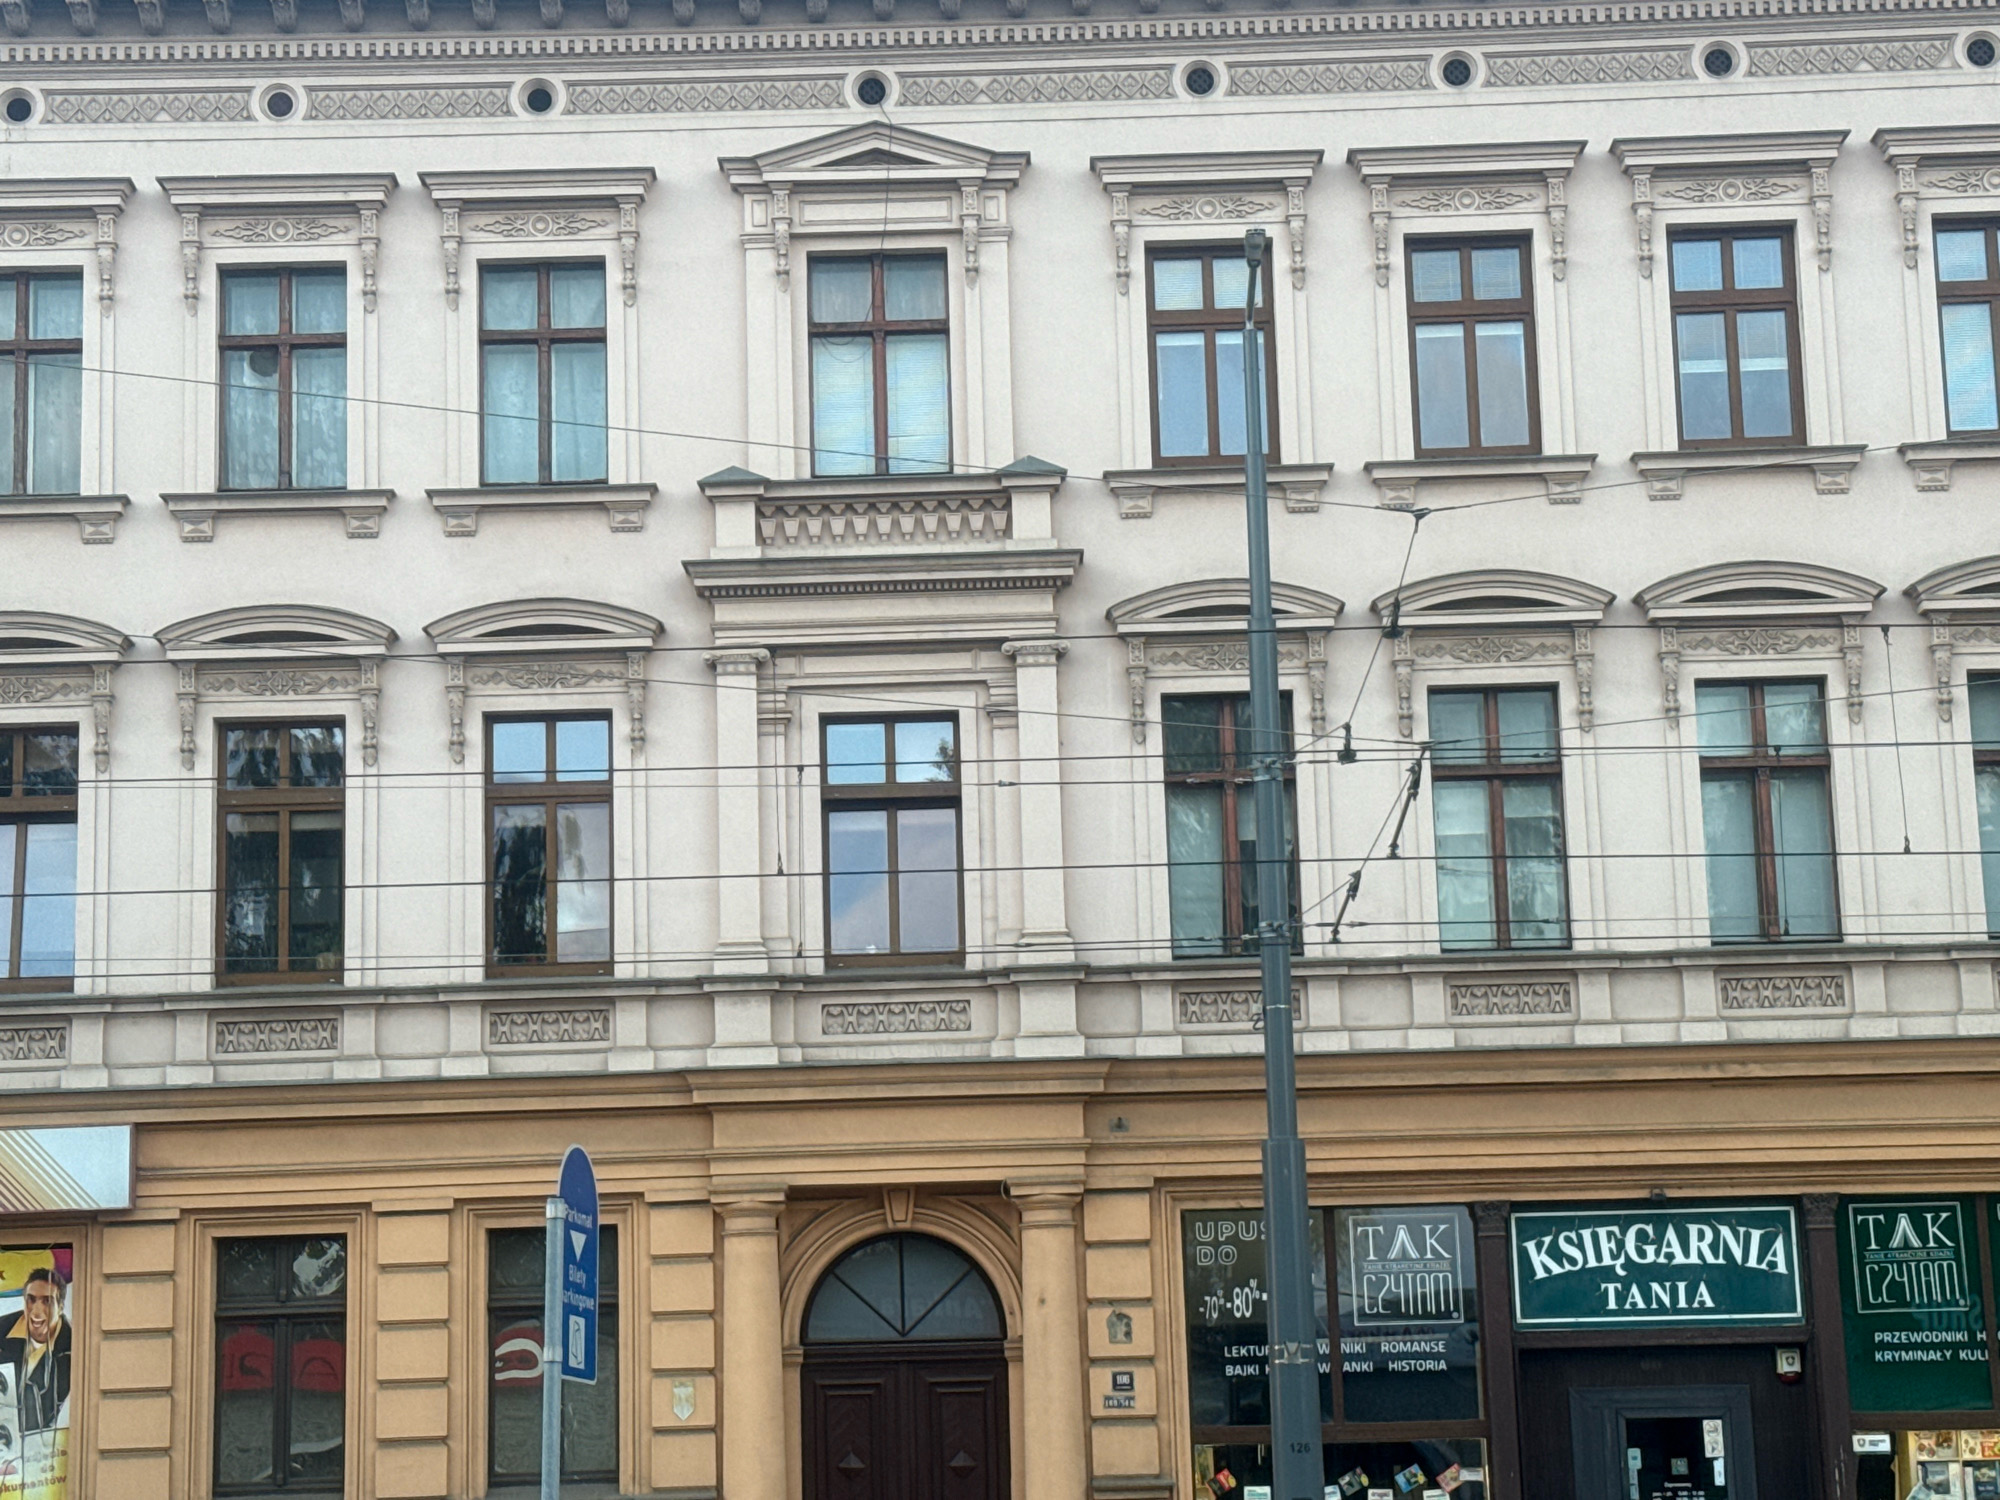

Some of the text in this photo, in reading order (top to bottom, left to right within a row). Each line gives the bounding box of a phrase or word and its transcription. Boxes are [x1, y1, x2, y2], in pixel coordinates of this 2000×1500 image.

[564, 1204, 593, 1229] Parkomat
[1357, 1224, 1452, 1260] TAK
[1857, 1212, 1956, 1250] TAK
[1197, 1245, 1238, 1265] DO
[1522, 1222, 1789, 1280] KSIĘGARNIA
[569, 1264, 586, 1289] Bilety
[563, 1288, 594, 1312] arkingowe
[1600, 1281, 1715, 1309] TANIA
[1381, 1341, 1447, 1353] ROMANSE
[1874, 1331, 1968, 1343] PRZEWODNIKI
[1875, 1349, 1952, 1362] KRYMINAŁY
[1225, 1364, 1259, 1377] BAJKI
[1388, 1360, 1448, 1372] HISTORIA
[1290, 1442, 1311, 1454] 126
